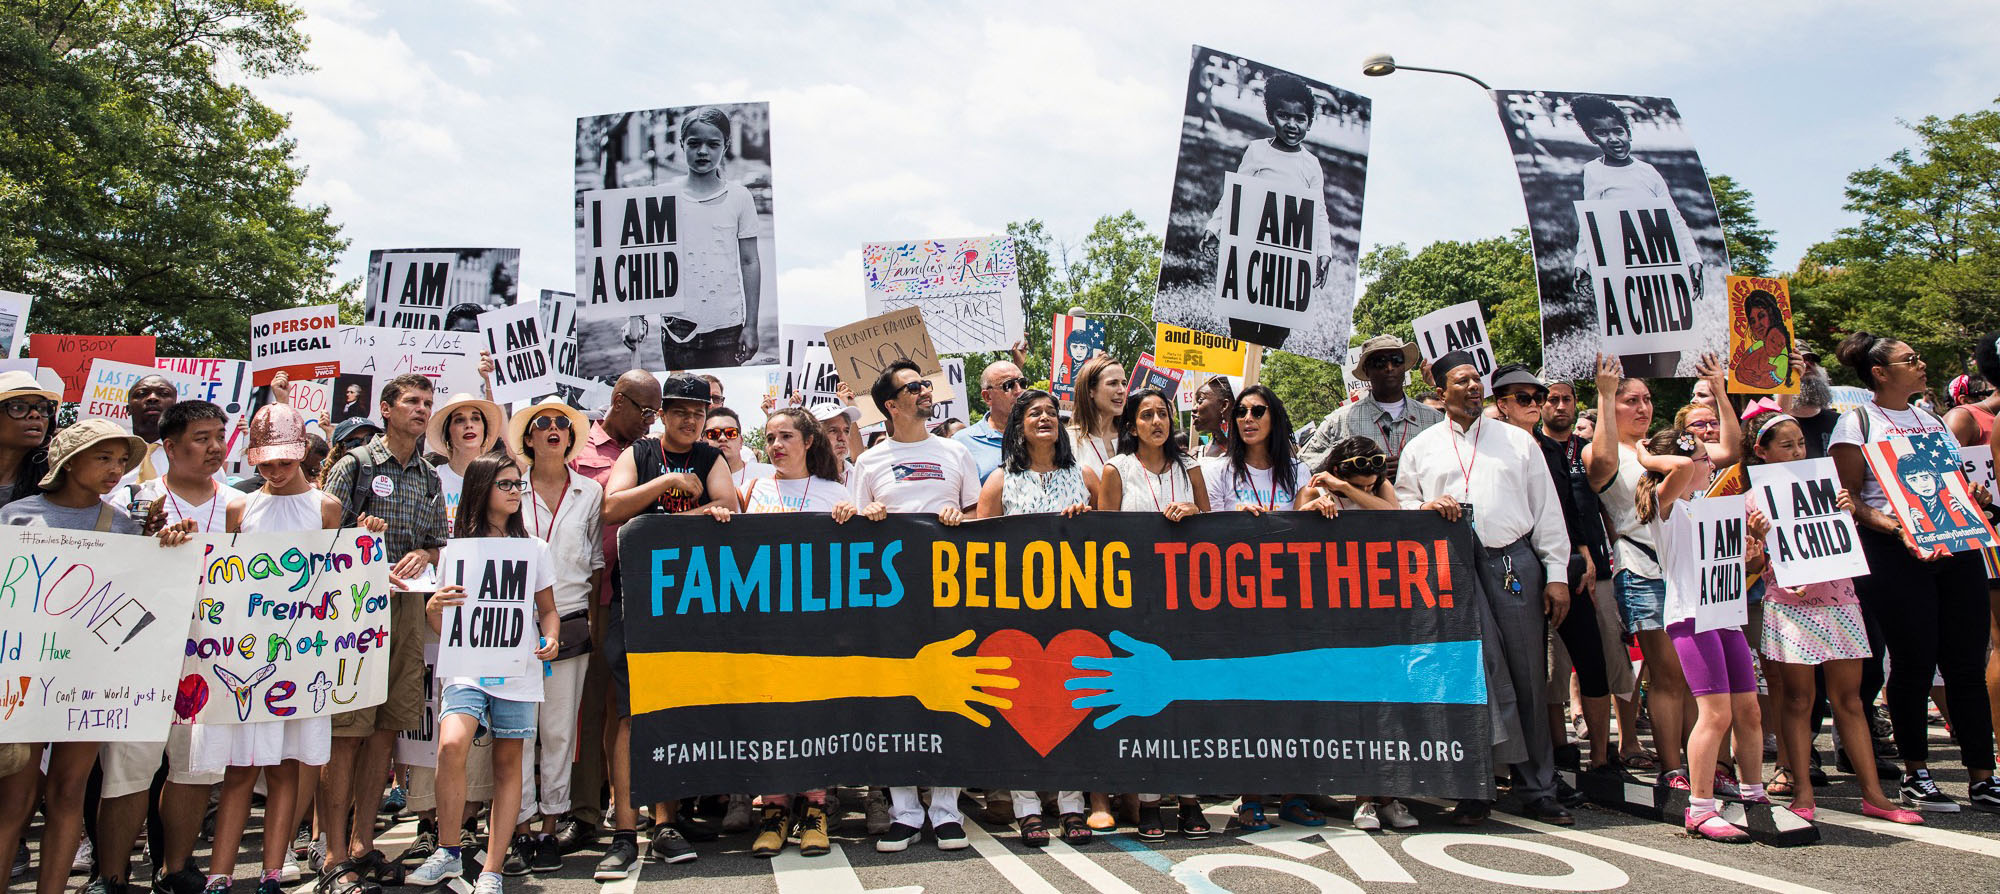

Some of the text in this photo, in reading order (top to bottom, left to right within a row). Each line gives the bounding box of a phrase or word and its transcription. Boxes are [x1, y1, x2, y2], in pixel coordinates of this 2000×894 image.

[592, 196, 677, 248] I AM
[1229, 184, 1314, 251] I AM
[1585, 209, 1681, 266] I AM
[381, 262, 449, 306] I AM
[592, 251, 678, 304] A CHILD
[1221, 246, 1312, 312] A CHILD
[551, 301, 561, 333] I
[1603, 274, 1693, 336] A CHILD
[57, 338, 118, 353] NO BODY
[253, 316, 336, 339] NO PERSON
[340, 327, 375, 348] This
[398, 330, 416, 346] Is
[487, 317, 540, 354] I AM
[833, 314, 921, 351] REUNITE FAMILIES
[1165, 330, 1239, 352] and Bigotry
[1424, 317, 1482, 359] I AM
[257, 336, 331, 357] IS ILLEGAL
[361, 354, 446, 373] A Moment
[850, 333, 928, 379] NOW
[1183, 353, 1206, 367] PSL
[98, 369, 120, 385] LAS
[495, 359, 506, 386] A
[507, 349, 547, 383] CHILD
[803, 362, 811, 390] I
[1236, 489, 1289, 504] FAMILIES
[1764, 485, 1779, 519] I
[1792, 479, 1840, 518] AM
[19, 531, 106, 549] #FamiliesBelongTogether
[1699, 518, 1741, 560] I AM
[1776, 519, 1851, 562] A CHILD
[1916, 527, 1986, 544] #EndFamilyDetention
[455, 560, 528, 600] I AM
[651, 539, 1454, 617] FAMILIES BELONG TOGETHER!
[1700, 563, 1741, 606] A CHILD
[350, 581, 388, 622] You
[267, 629, 328, 663] not
[335, 625, 389, 654] met
[448, 606, 524, 648] A CHILD
[39, 632, 71, 662] Have
[40, 677, 55, 707] Y
[81, 688, 96, 700] our
[134, 688, 156, 707] just
[161, 688, 172, 702] be
[68, 708, 129, 731] FAIR?!
[653, 732, 943, 766] #FAMILIESBELONGTOGETHER
[1119, 738, 1465, 762] FAMILIESBELONGTOGETHER.ORG
